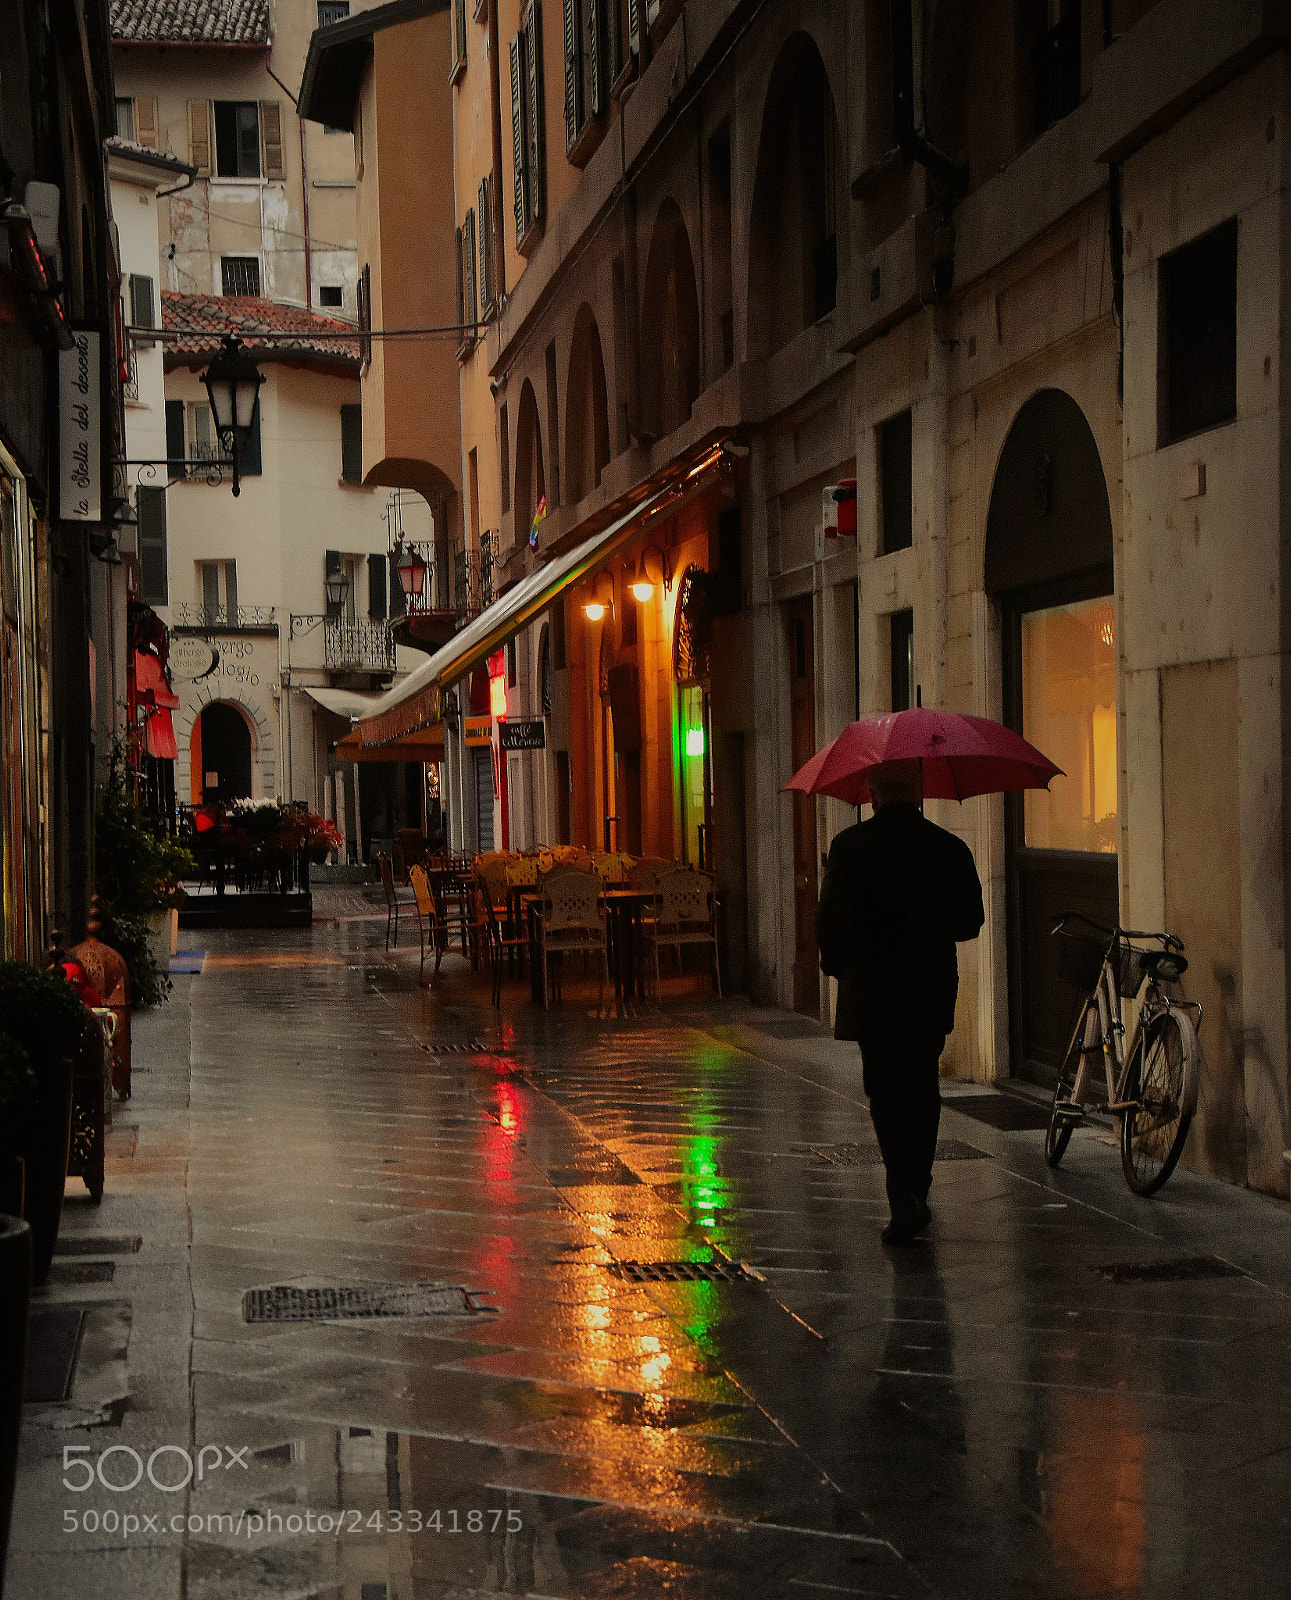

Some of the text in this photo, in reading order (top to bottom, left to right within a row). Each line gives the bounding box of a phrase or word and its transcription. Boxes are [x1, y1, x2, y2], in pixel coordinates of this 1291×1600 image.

[71, 334, 89, 395] deserto
[71, 403, 89, 431] del
[71, 441, 90, 489] Stella
